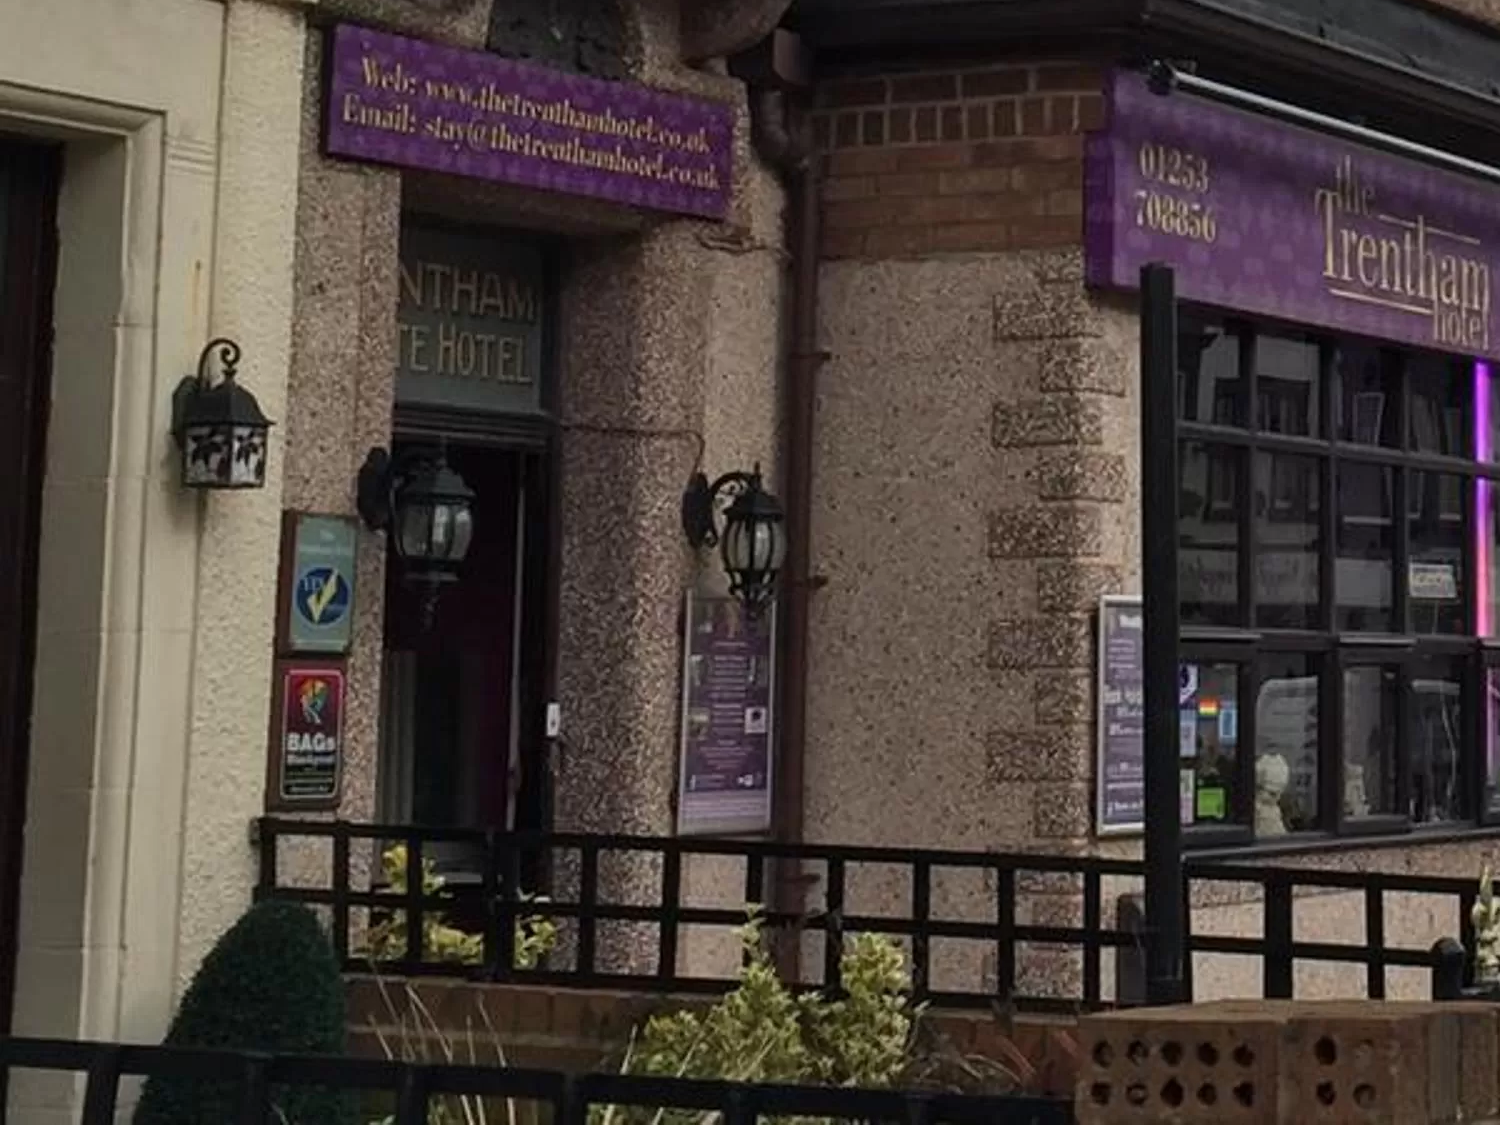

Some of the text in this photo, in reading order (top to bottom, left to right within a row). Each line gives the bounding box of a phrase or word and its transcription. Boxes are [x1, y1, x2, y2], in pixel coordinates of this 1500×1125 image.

[342, 92, 416, 134] Email:
[362, 56, 710, 154] Web: www.thetrenthamhotel.co.uk
[1140, 143, 1209, 193] 01253
[1336, 154, 1376, 217] the
[1315, 188, 1490, 312] Trentham
[436, 321, 533, 383] HOTEL
[1433, 299, 1490, 352] hotel
